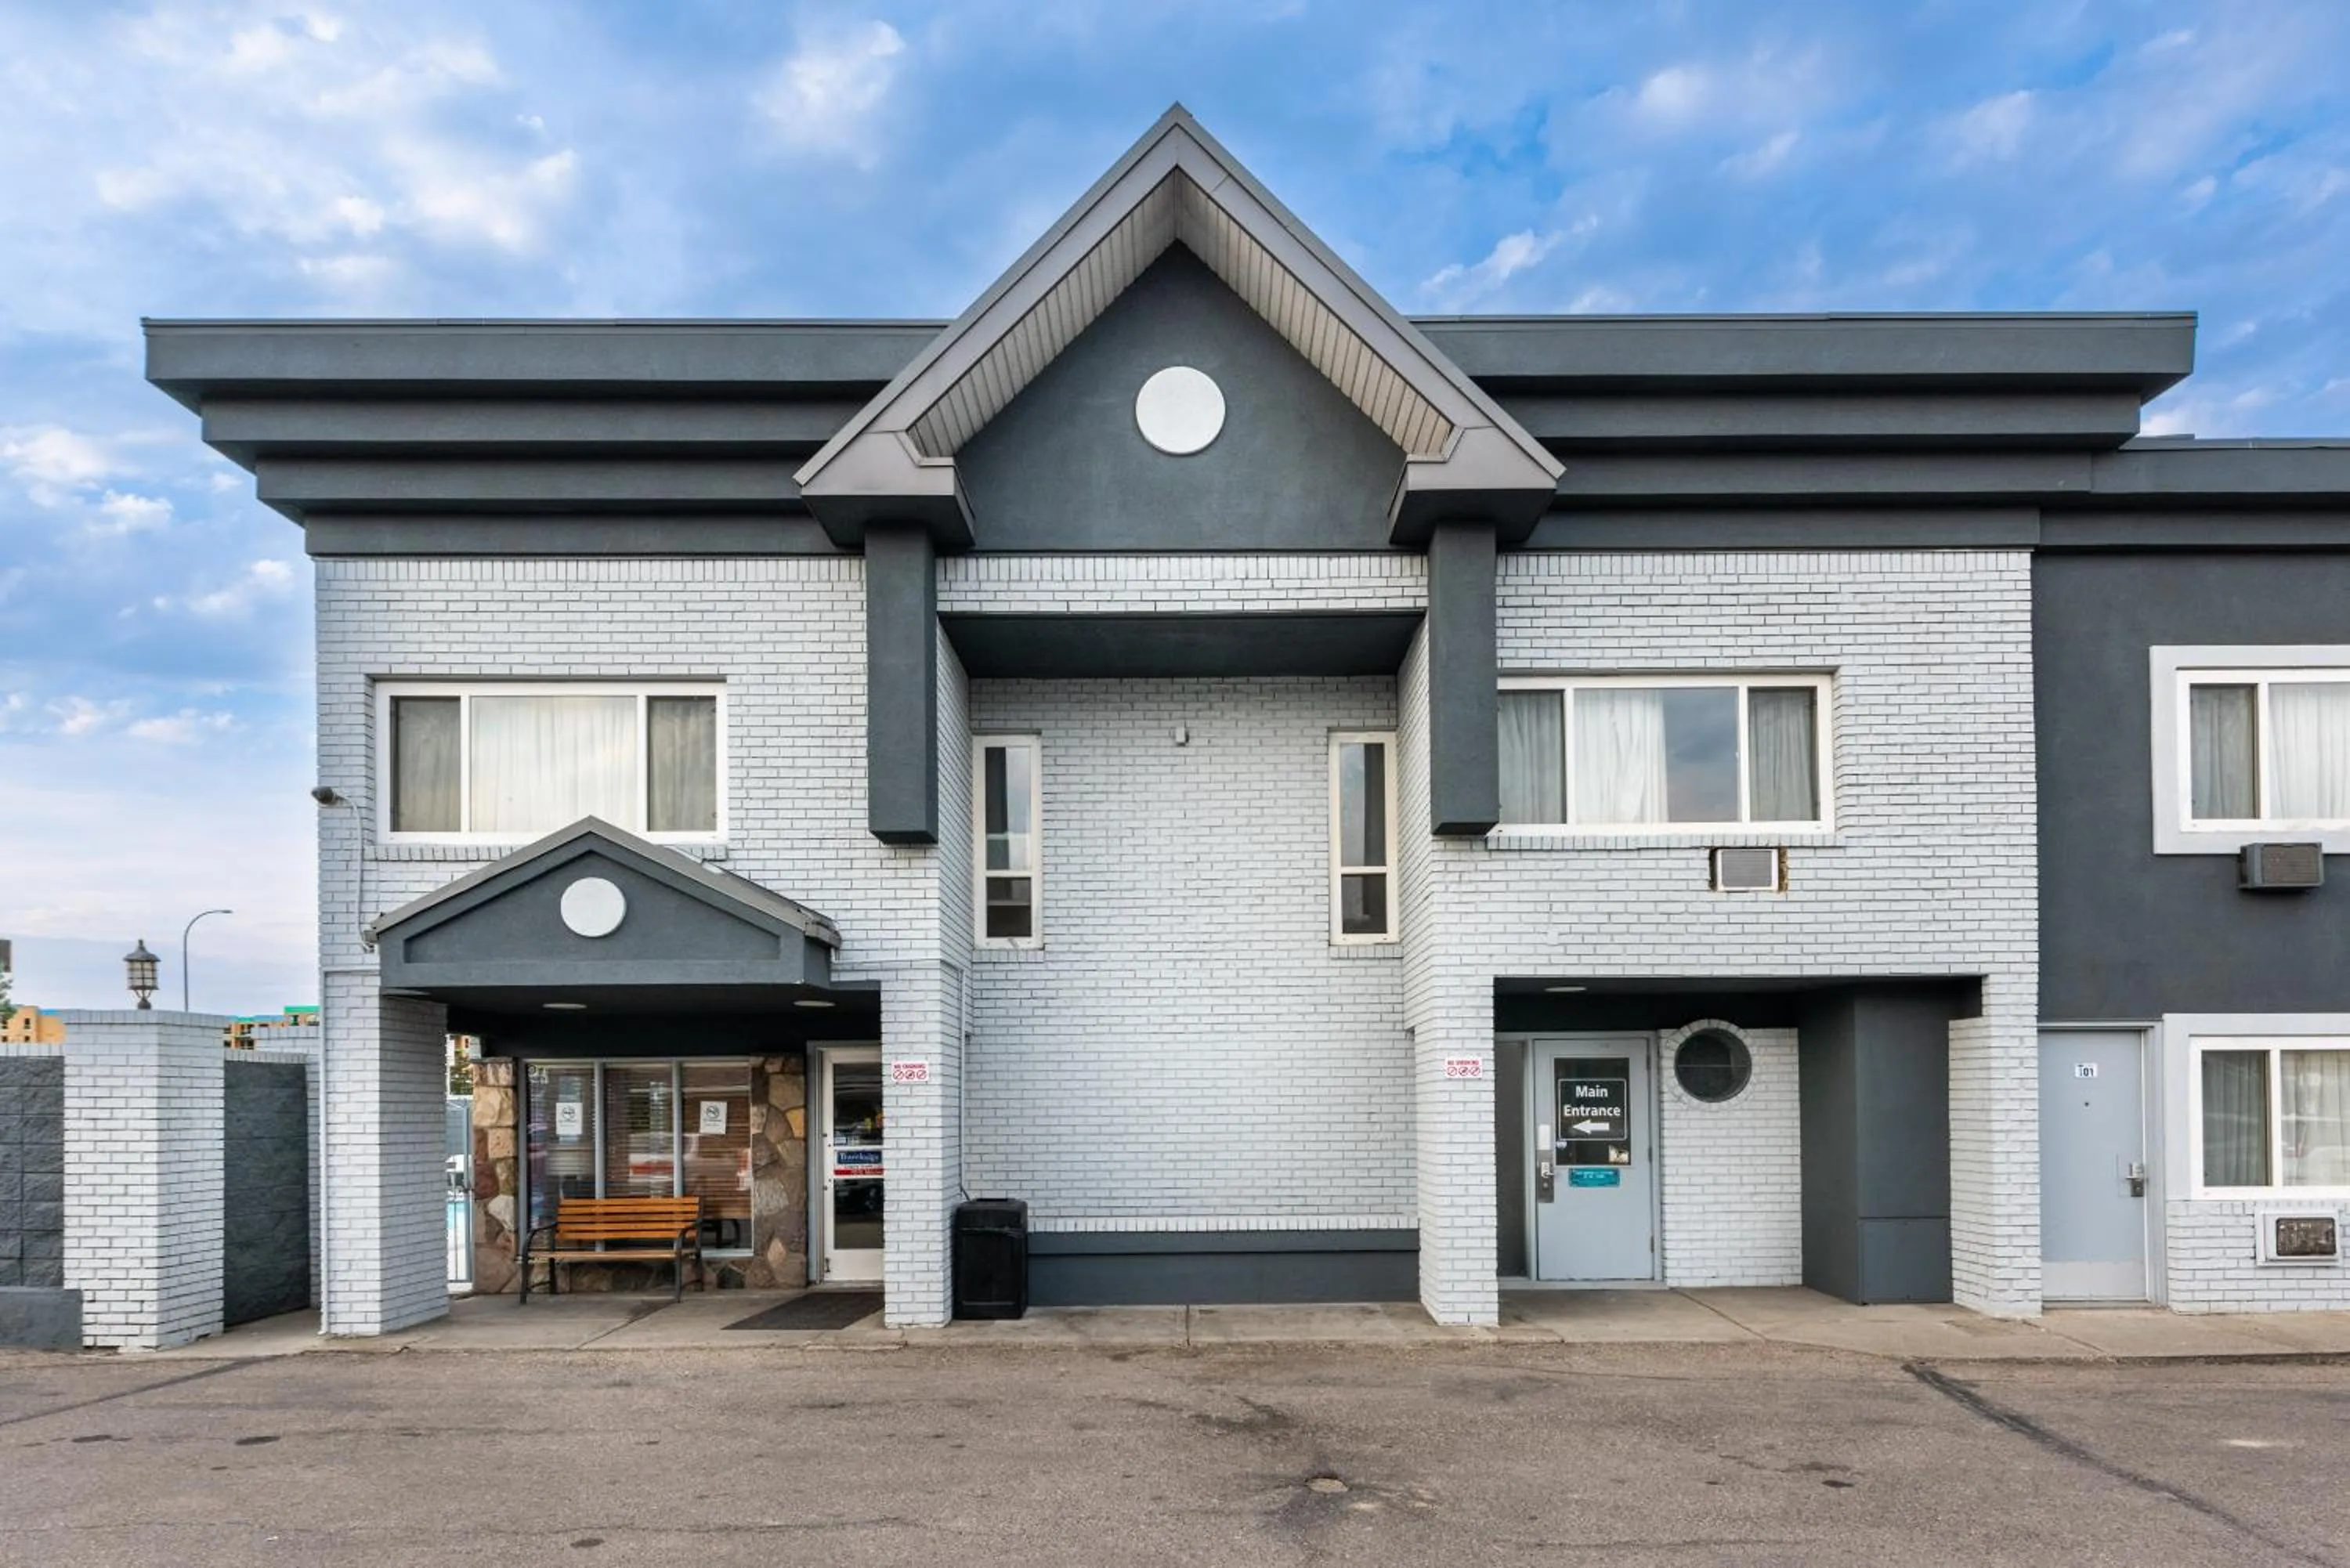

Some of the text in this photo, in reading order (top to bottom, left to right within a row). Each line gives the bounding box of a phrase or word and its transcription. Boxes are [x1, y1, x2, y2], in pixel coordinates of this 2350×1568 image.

[2079, 1066, 2094, 1076] 101
[1575, 1085, 1608, 1097] Main
[1564, 1104, 1621, 1117] Entrance
